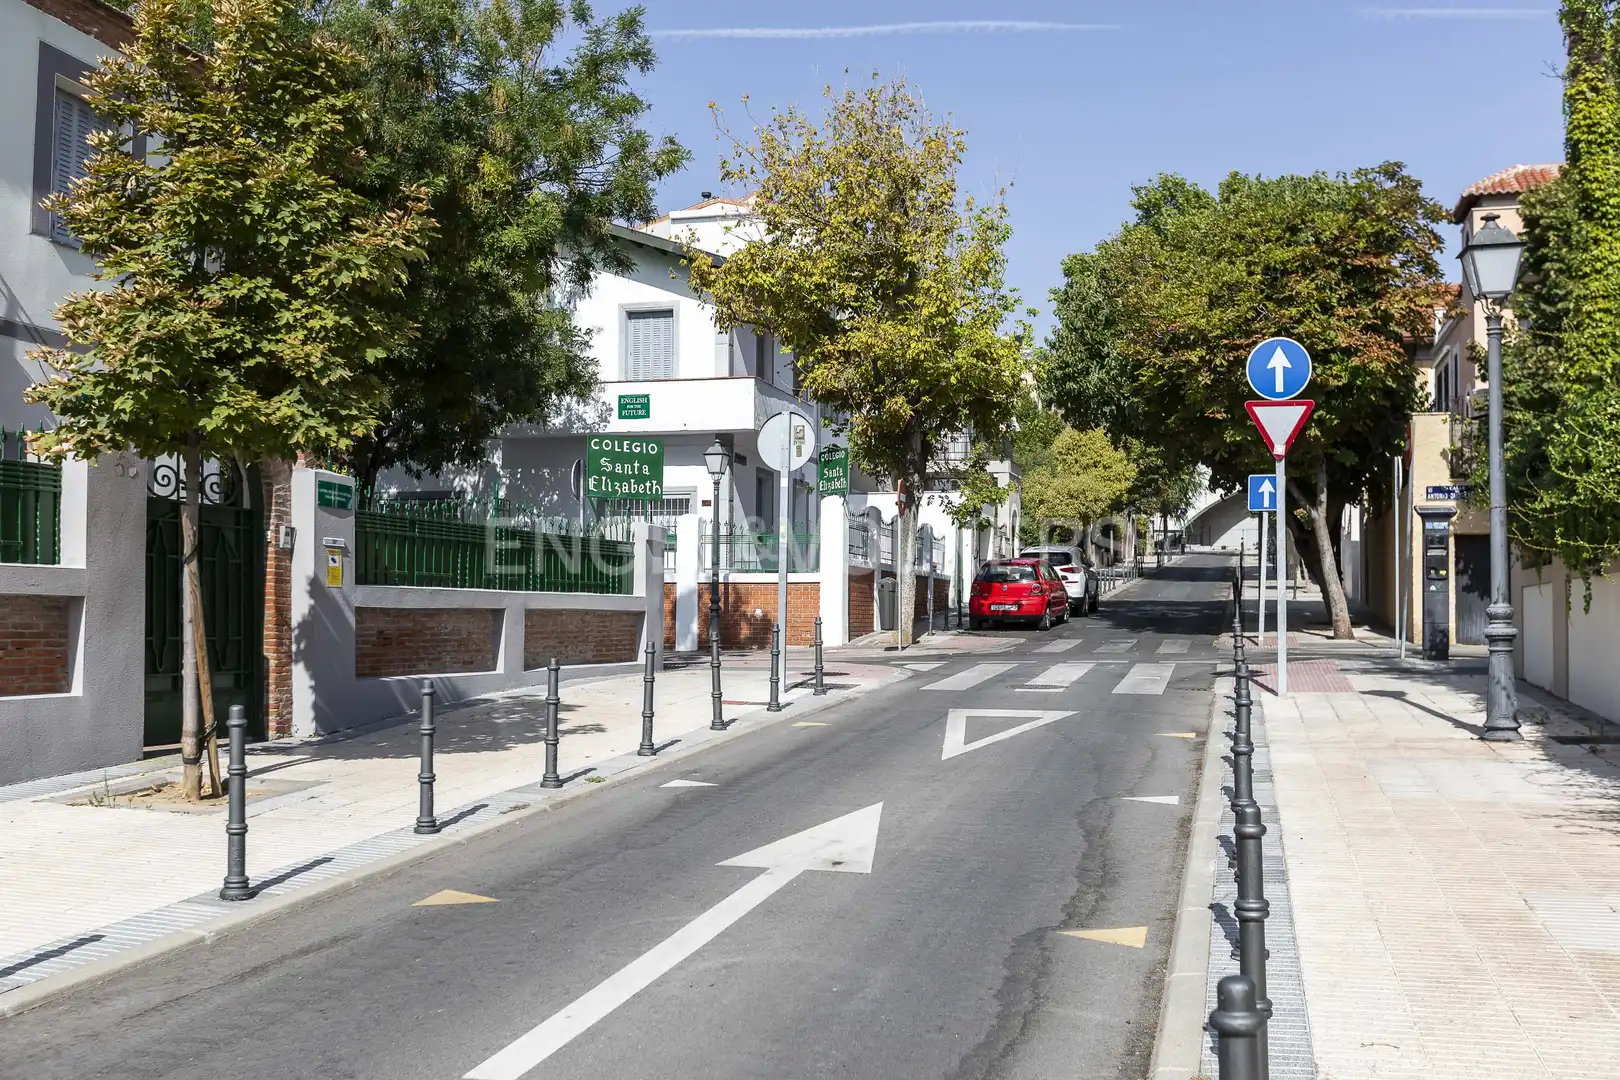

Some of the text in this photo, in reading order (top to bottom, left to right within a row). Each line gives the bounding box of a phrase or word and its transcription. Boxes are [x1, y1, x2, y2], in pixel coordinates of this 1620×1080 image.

[591, 438, 658, 454] COLEGIO
[820, 450, 845, 462] COLEGIO
[600, 457, 650, 475] Santa
[823, 465, 844, 479] Santa
[588, 475, 661, 496] Elizabeth
[819, 477, 848, 492] Elizabeth
